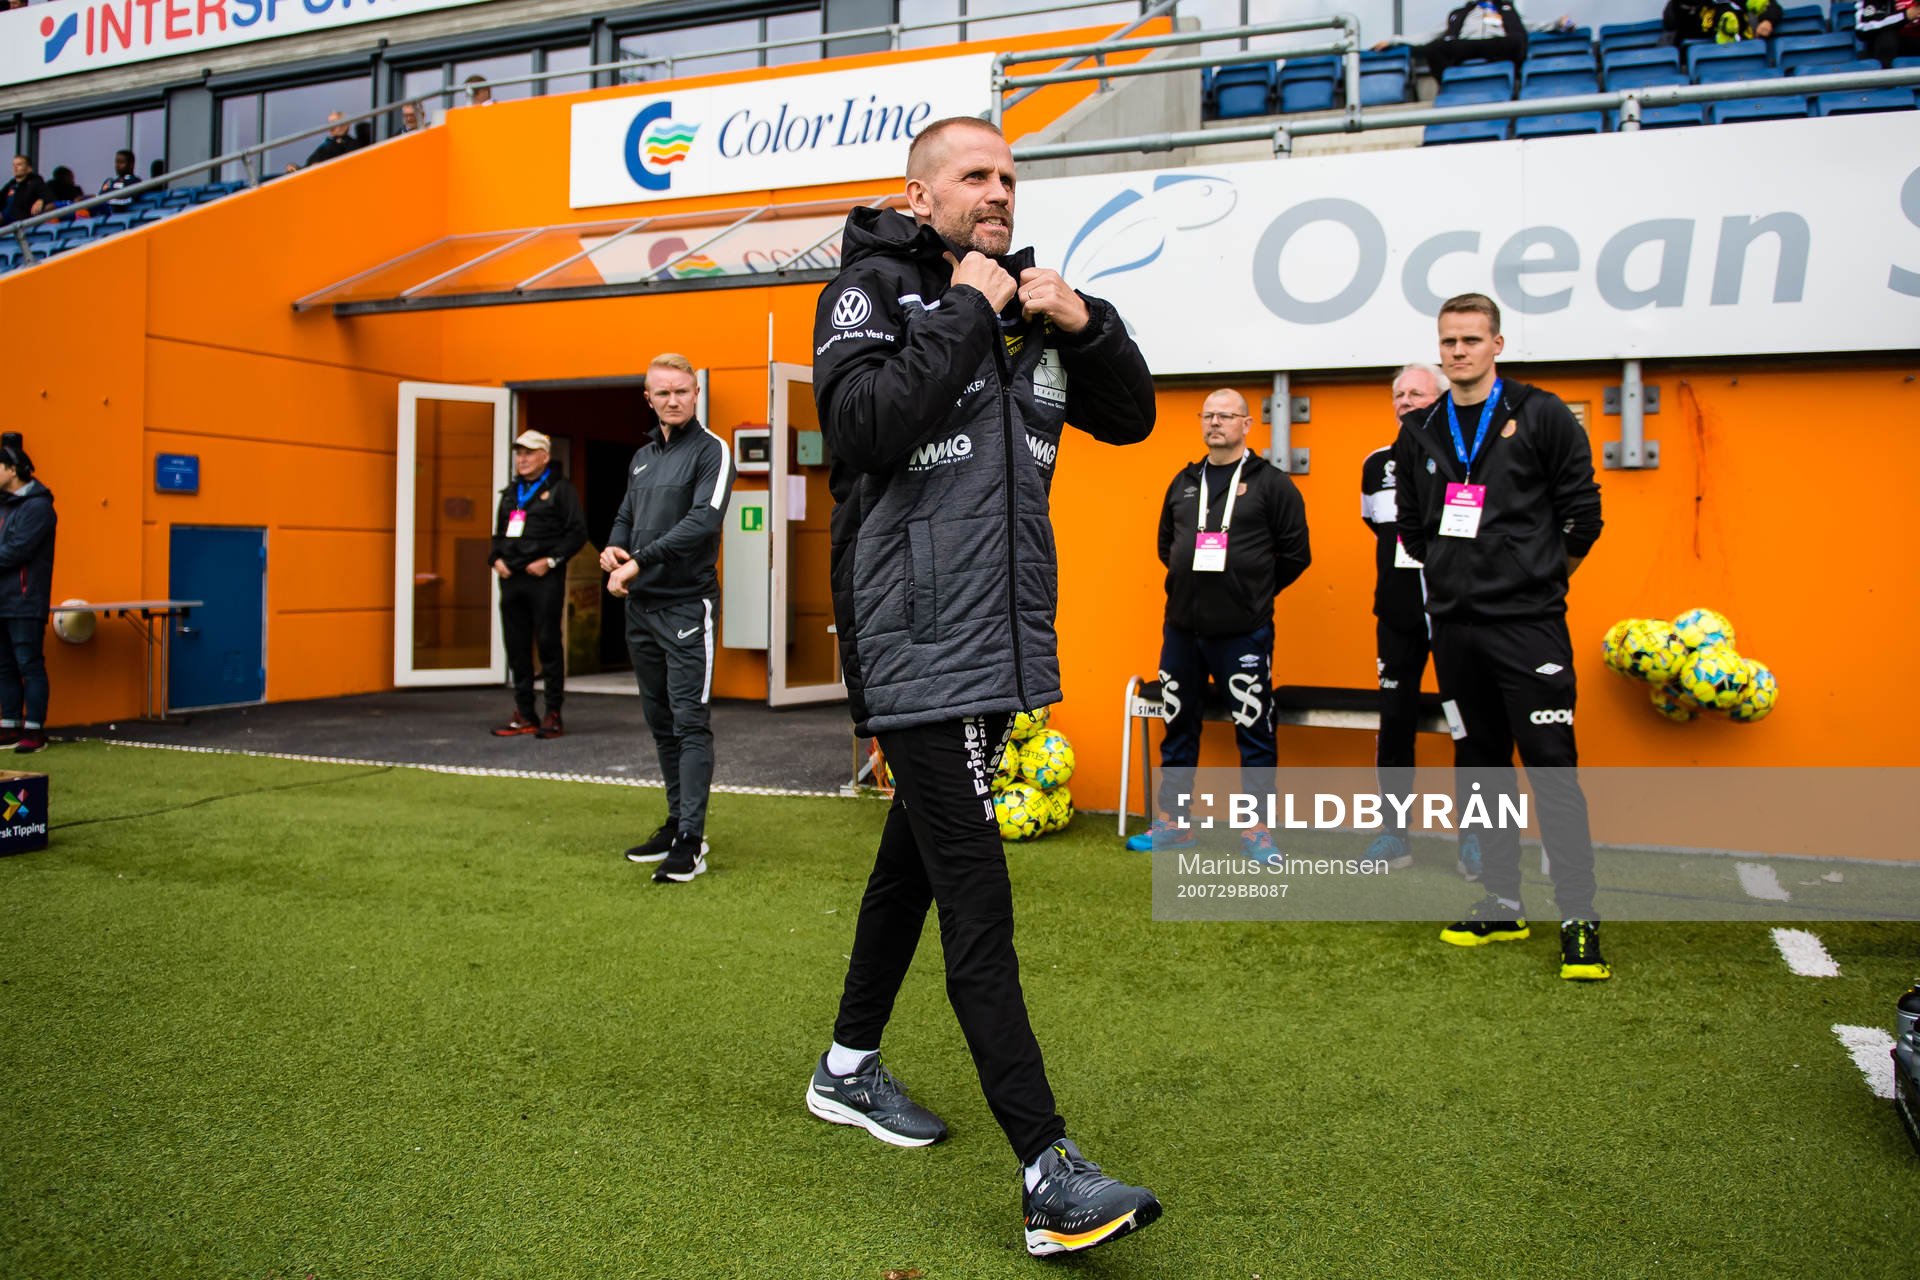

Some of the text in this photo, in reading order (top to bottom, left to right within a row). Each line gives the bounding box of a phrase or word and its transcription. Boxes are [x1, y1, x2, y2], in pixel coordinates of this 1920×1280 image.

[86, 0, 398, 55] INTERS
[1251, 197, 1811, 325] Ocean
[842, 330, 864, 340] Auto
[865, 329, 884, 339] Vest
[13, 822, 46, 838] Tipping
